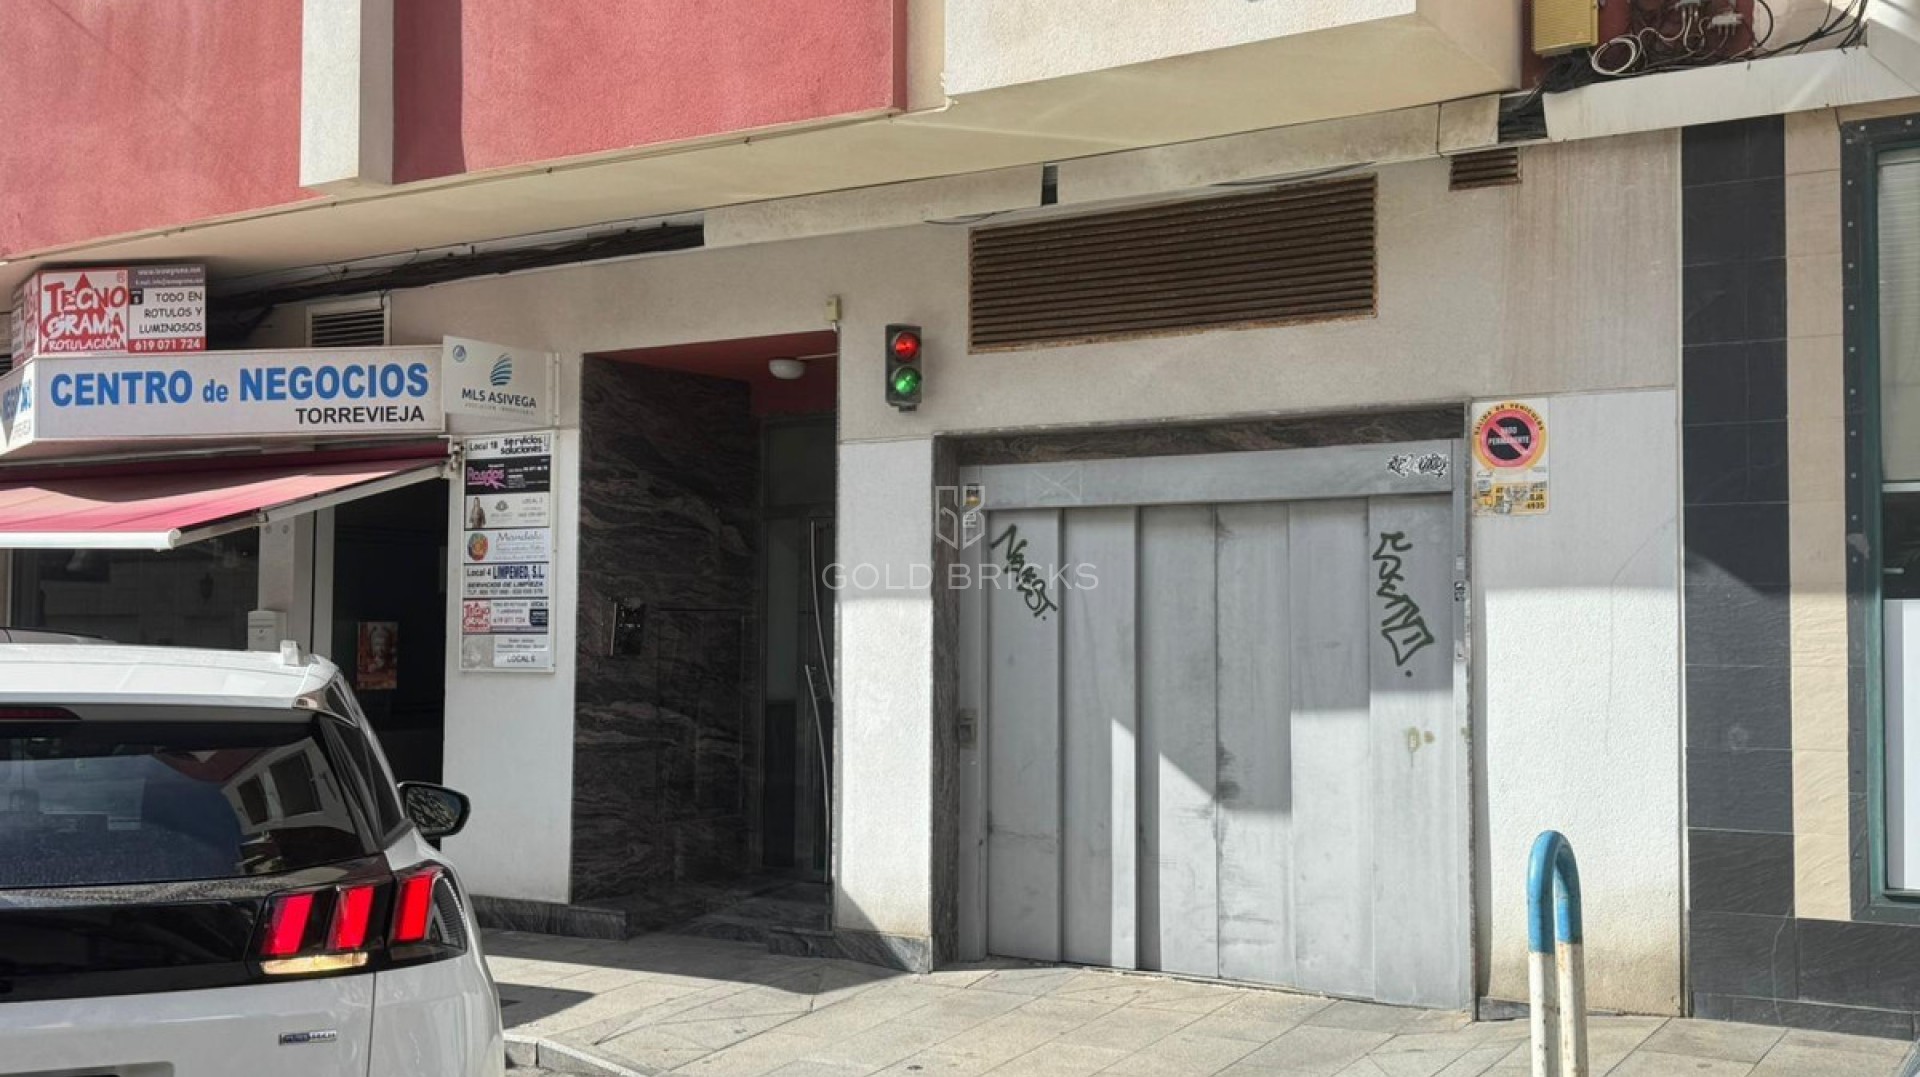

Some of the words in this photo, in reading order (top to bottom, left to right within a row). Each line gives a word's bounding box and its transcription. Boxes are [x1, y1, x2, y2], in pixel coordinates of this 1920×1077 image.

[44, 281, 126, 312] TECNO
[155, 292, 184, 302] TODO
[188, 291, 203, 301] EN
[144, 307, 192, 318] ROTULOS
[195, 306, 203, 316] Y
[42, 311, 124, 338] GRAMA
[139, 323, 202, 334] LUMINOSOS
[135, 340, 154, 351] 619
[157, 339, 177, 350] 071
[180, 338, 201, 349] 724
[51, 369, 193, 407] CENTRO
[202, 379, 229, 403] de
[239, 362, 430, 402] NEGOCIOS
[461, 387, 485, 402] MLS
[488, 391, 537, 408] ASIVEGA
[295, 405, 425, 425] TORREVIEJA
[469, 440, 488, 451] Local
[467, 567, 485, 577] Local
